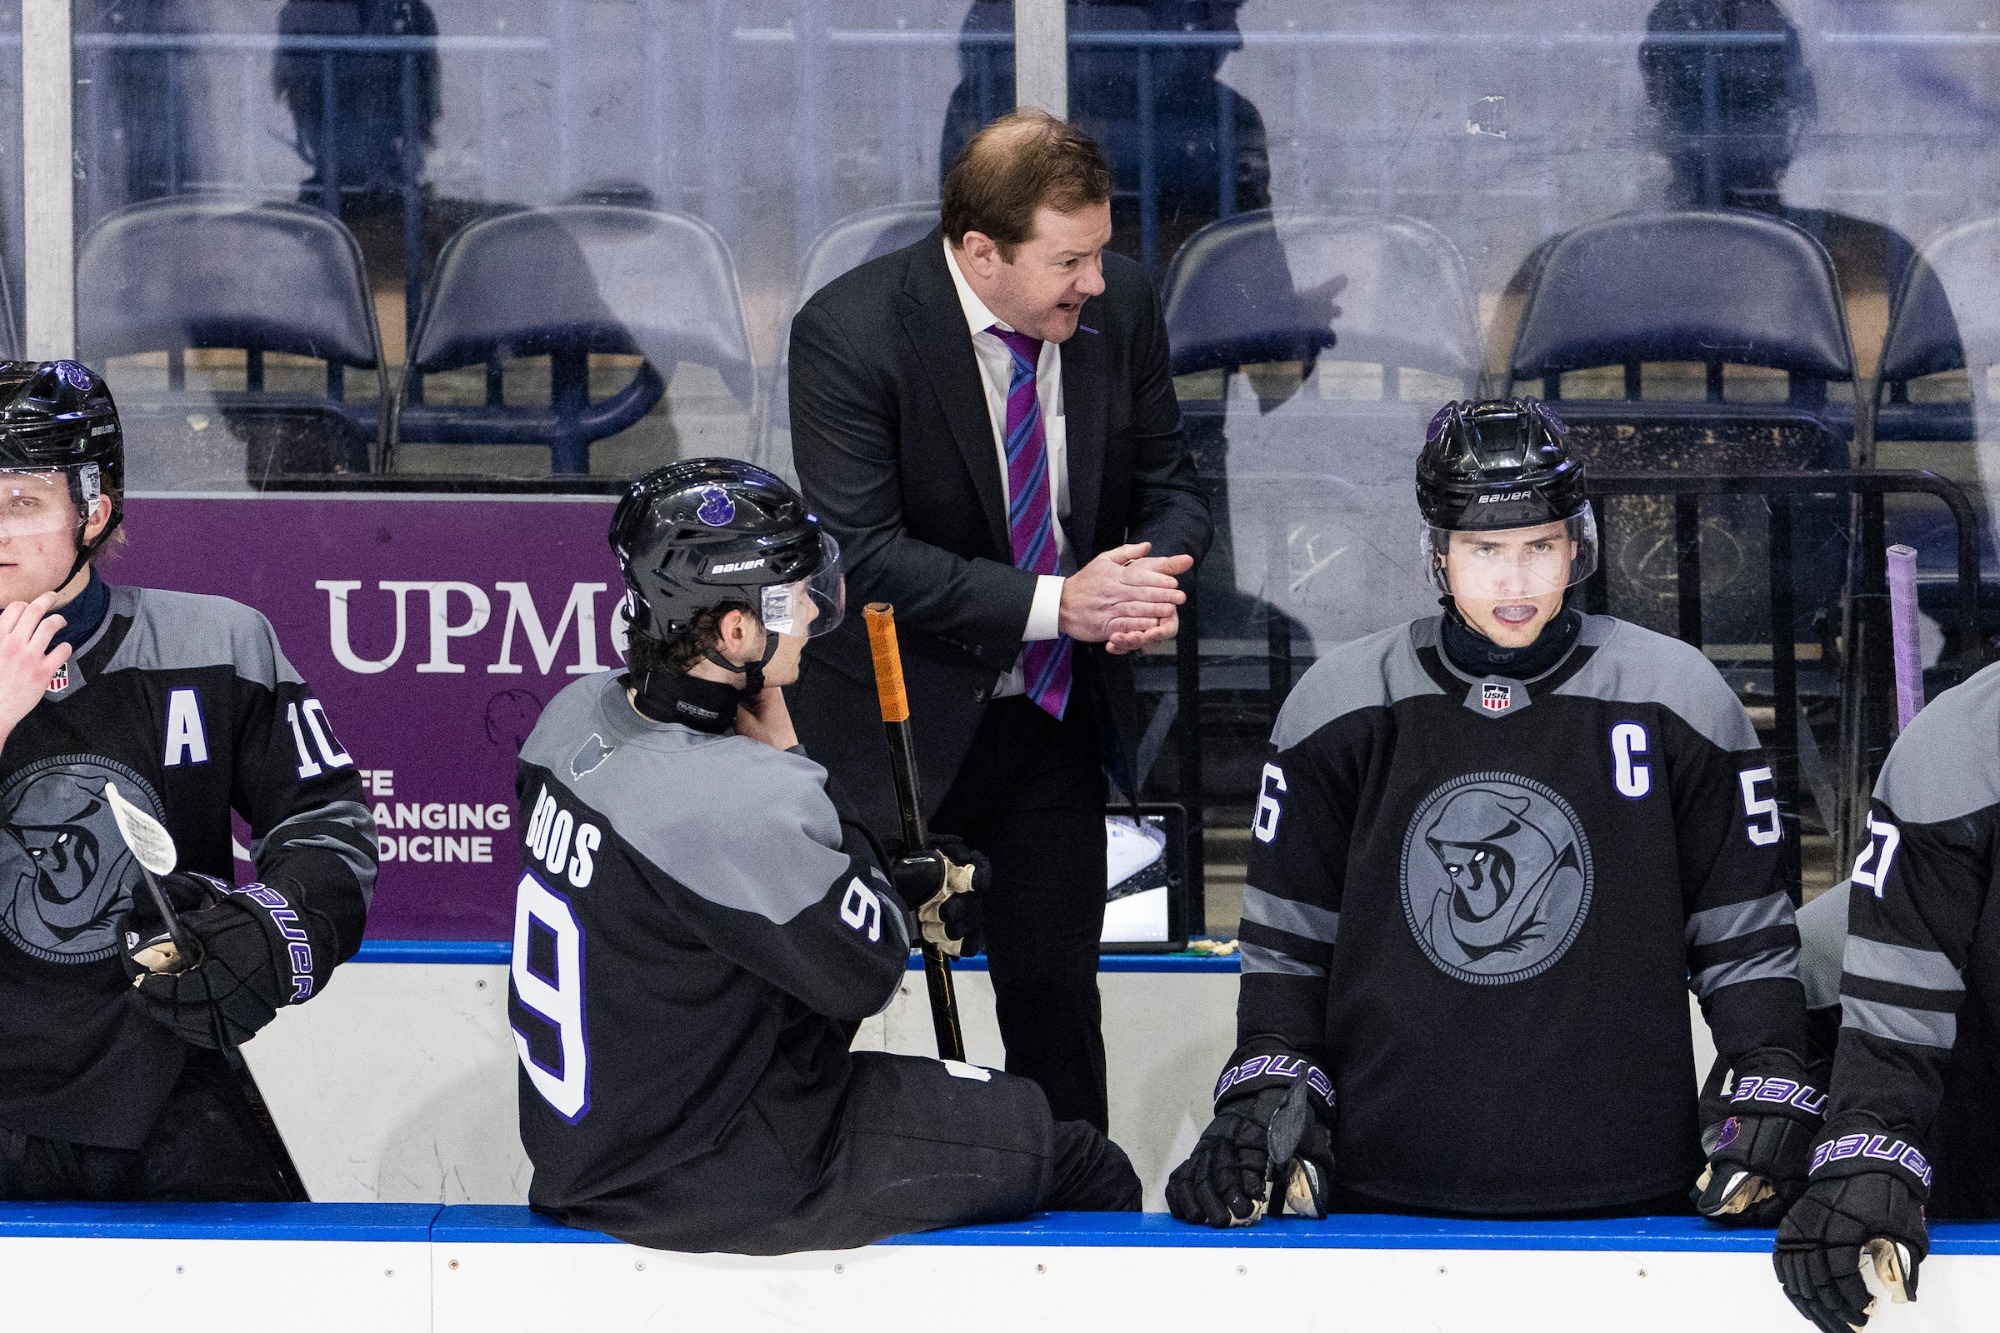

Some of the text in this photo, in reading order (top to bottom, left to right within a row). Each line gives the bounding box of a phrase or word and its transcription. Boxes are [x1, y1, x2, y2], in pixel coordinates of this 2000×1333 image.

[315, 580, 631, 676] UPM
[163, 688, 209, 767] A
[1484, 692, 1509, 700] USHL
[287, 699, 354, 779] 10
[1611, 723, 1650, 798] C
[372, 803, 511, 831] ANGING
[525, 782, 602, 888] BOOS
[1251, 762, 1287, 843] 6
[1739, 766, 1785, 846] 5
[379, 836, 493, 863] DICINE
[1851, 809, 1901, 898] 27
[840, 876, 881, 942] 9
[511, 871, 587, 1119] 9
[1730, 1076, 1829, 1121] BAU
